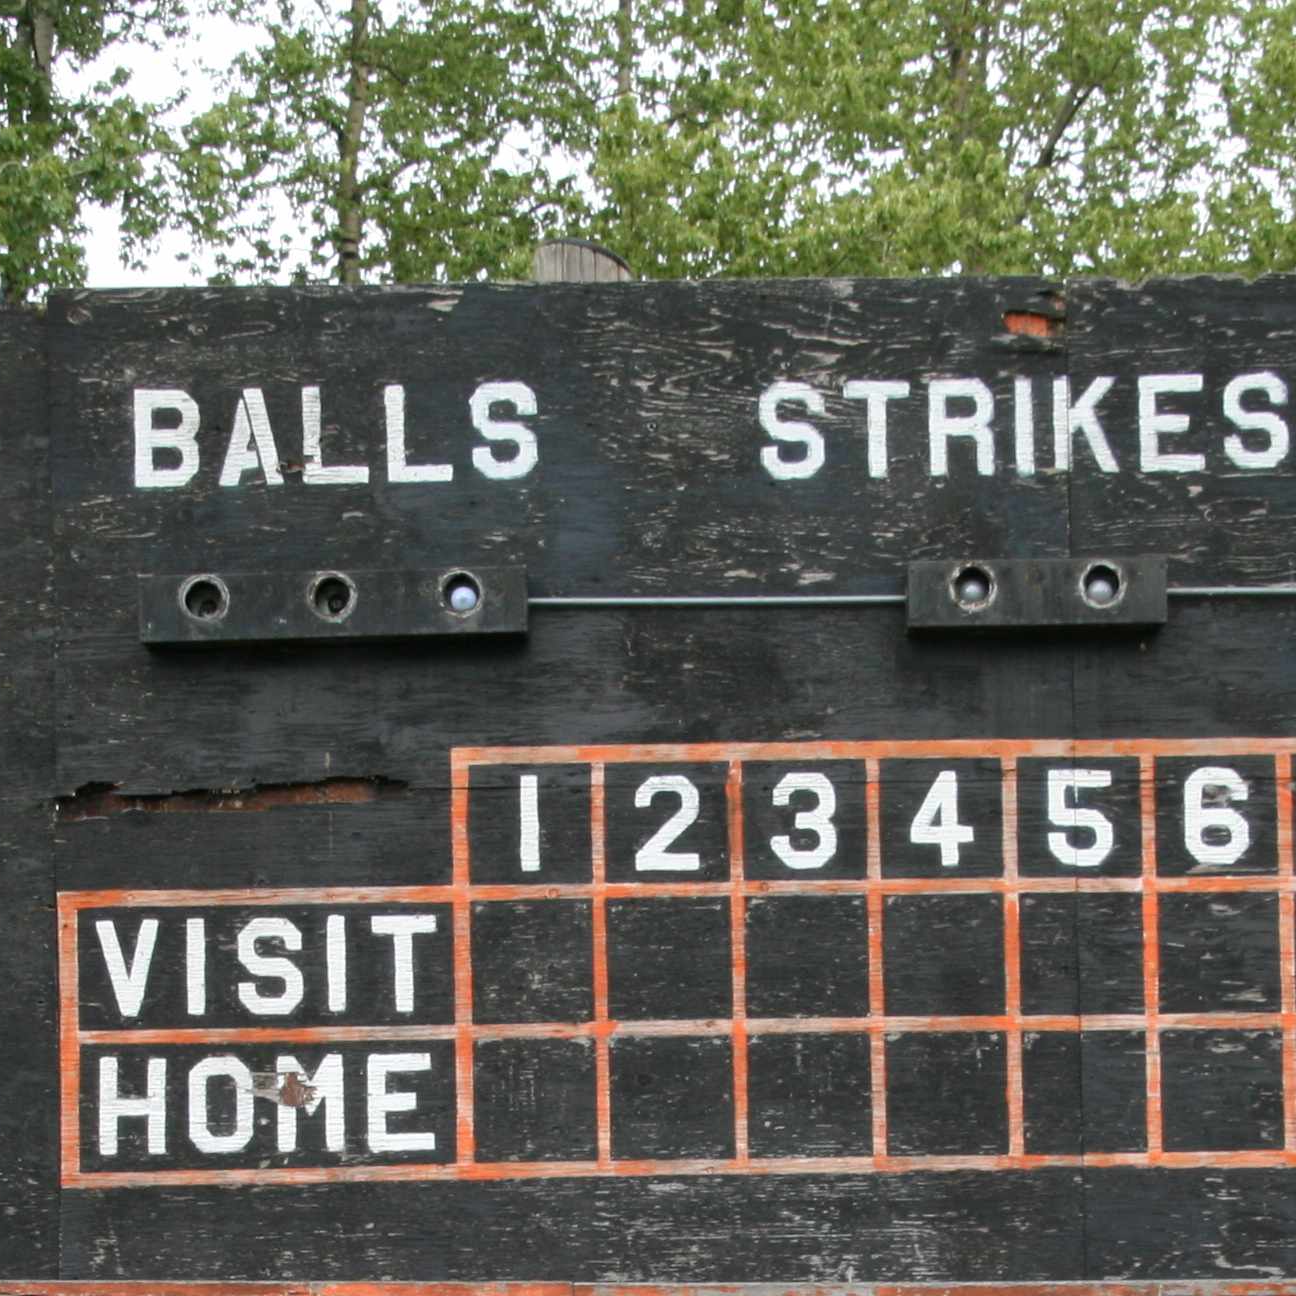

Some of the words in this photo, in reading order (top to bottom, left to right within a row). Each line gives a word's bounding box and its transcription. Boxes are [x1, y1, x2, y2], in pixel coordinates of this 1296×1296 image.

[132, 380, 540, 489] BALLS
[757, 371, 1291, 480] STRIKES
[519, 775, 541, 872] 1
[633, 775, 701, 872] 2
[769, 772, 837, 870] 3
[910, 770, 974, 866] 4
[1047, 770, 1114, 866] 5
[1182, 767, 1250, 866] 6
[95, 914, 436, 1017] VISIT
[97, 1052, 436, 1156] HOME
